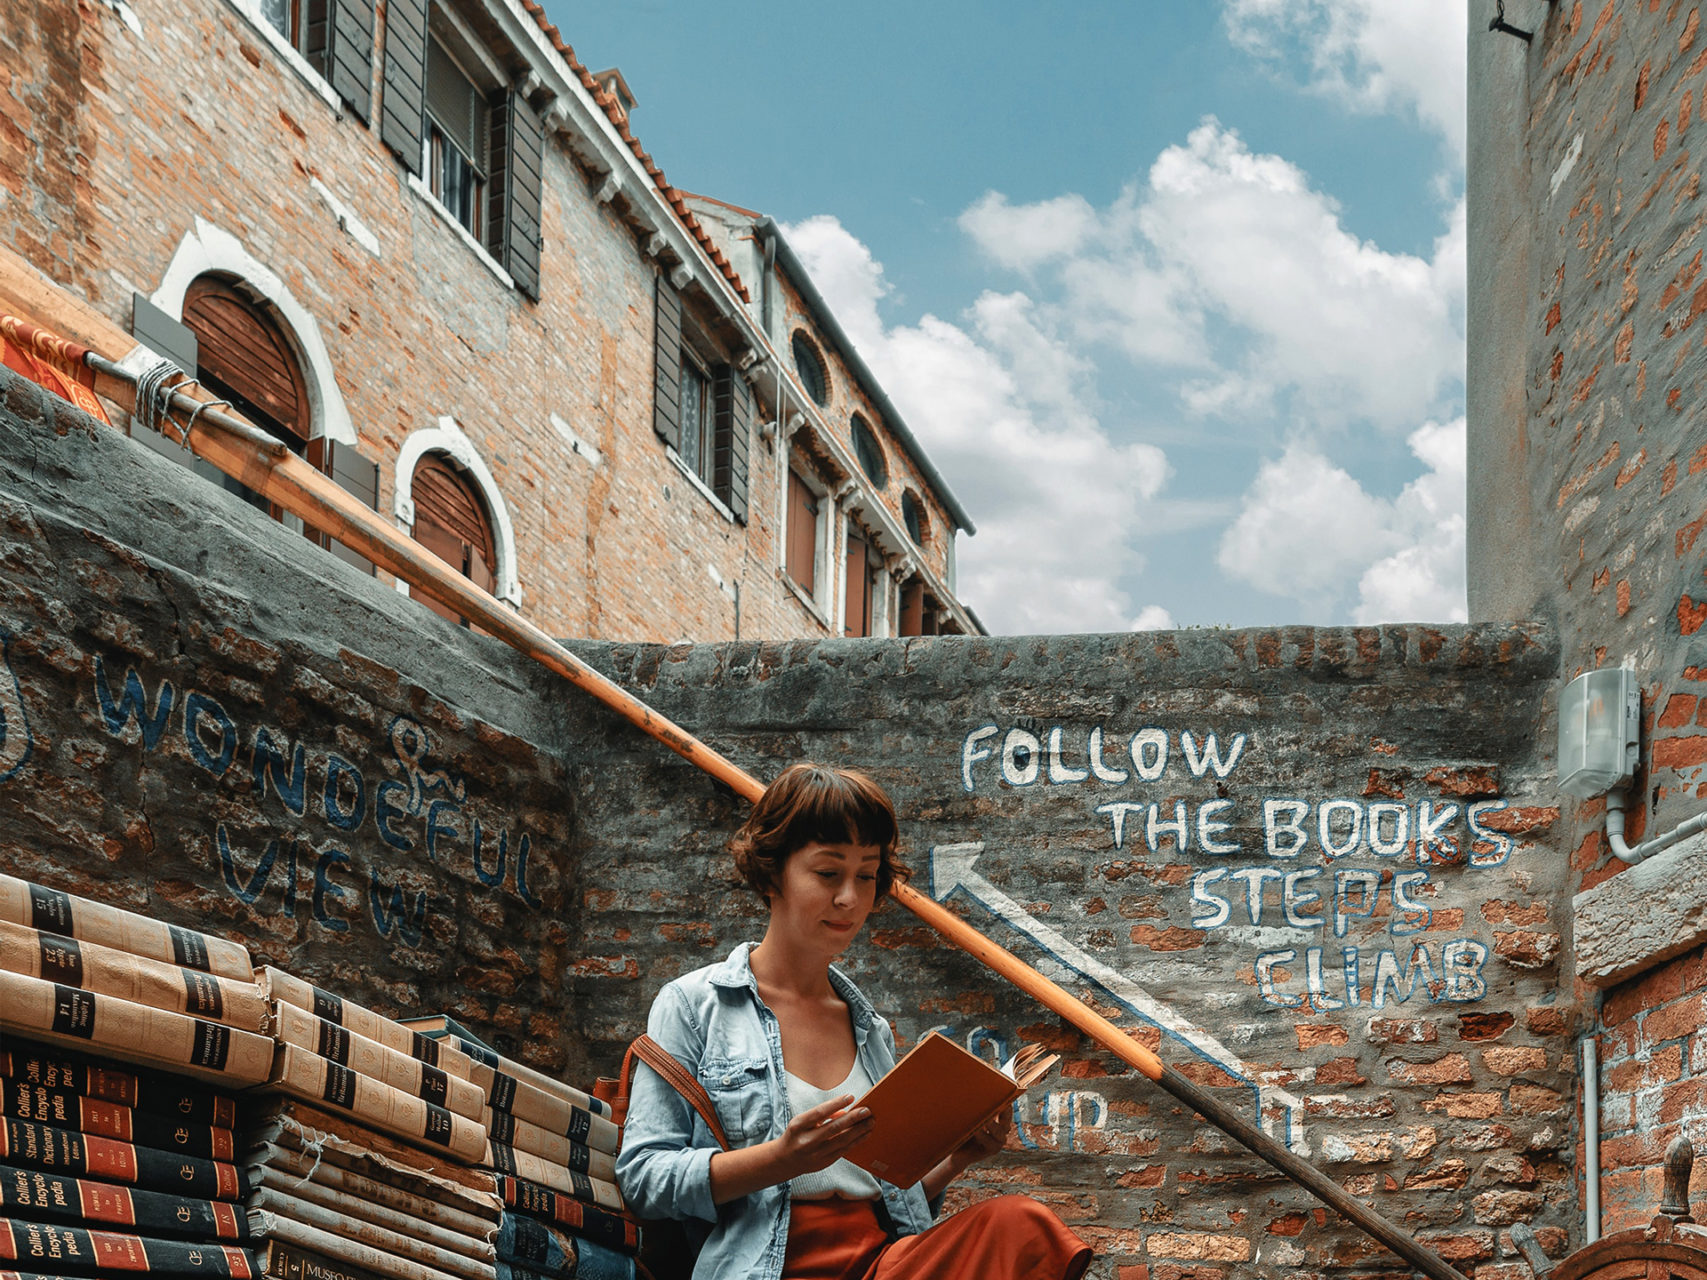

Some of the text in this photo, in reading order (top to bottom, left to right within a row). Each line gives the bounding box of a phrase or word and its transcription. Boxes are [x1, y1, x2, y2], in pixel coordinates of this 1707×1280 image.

[961, 723, 1247, 792] FOLLOW
[95, 654, 542, 909] WONDEFUL
[1095, 797, 1518, 869] THE BOOKS
[216, 823, 428, 948] VIEW
[1190, 867, 1431, 939] STEPS
[44, 947, 57, 964] 23
[1255, 937, 1489, 1014] CLIMB
[17, 1082, 31, 1118] Collier's
[51, 1094, 68, 1121] pedia
[23, 1121, 38, 1160] Standard
[42, 1124, 56, 1166] Dictionary
[15, 1170, 31, 1206] Collier's
[50, 1180, 69, 1207] pedia
[25, 1222, 45, 1258] Collier's
[61, 1230, 82, 1256] pedia
